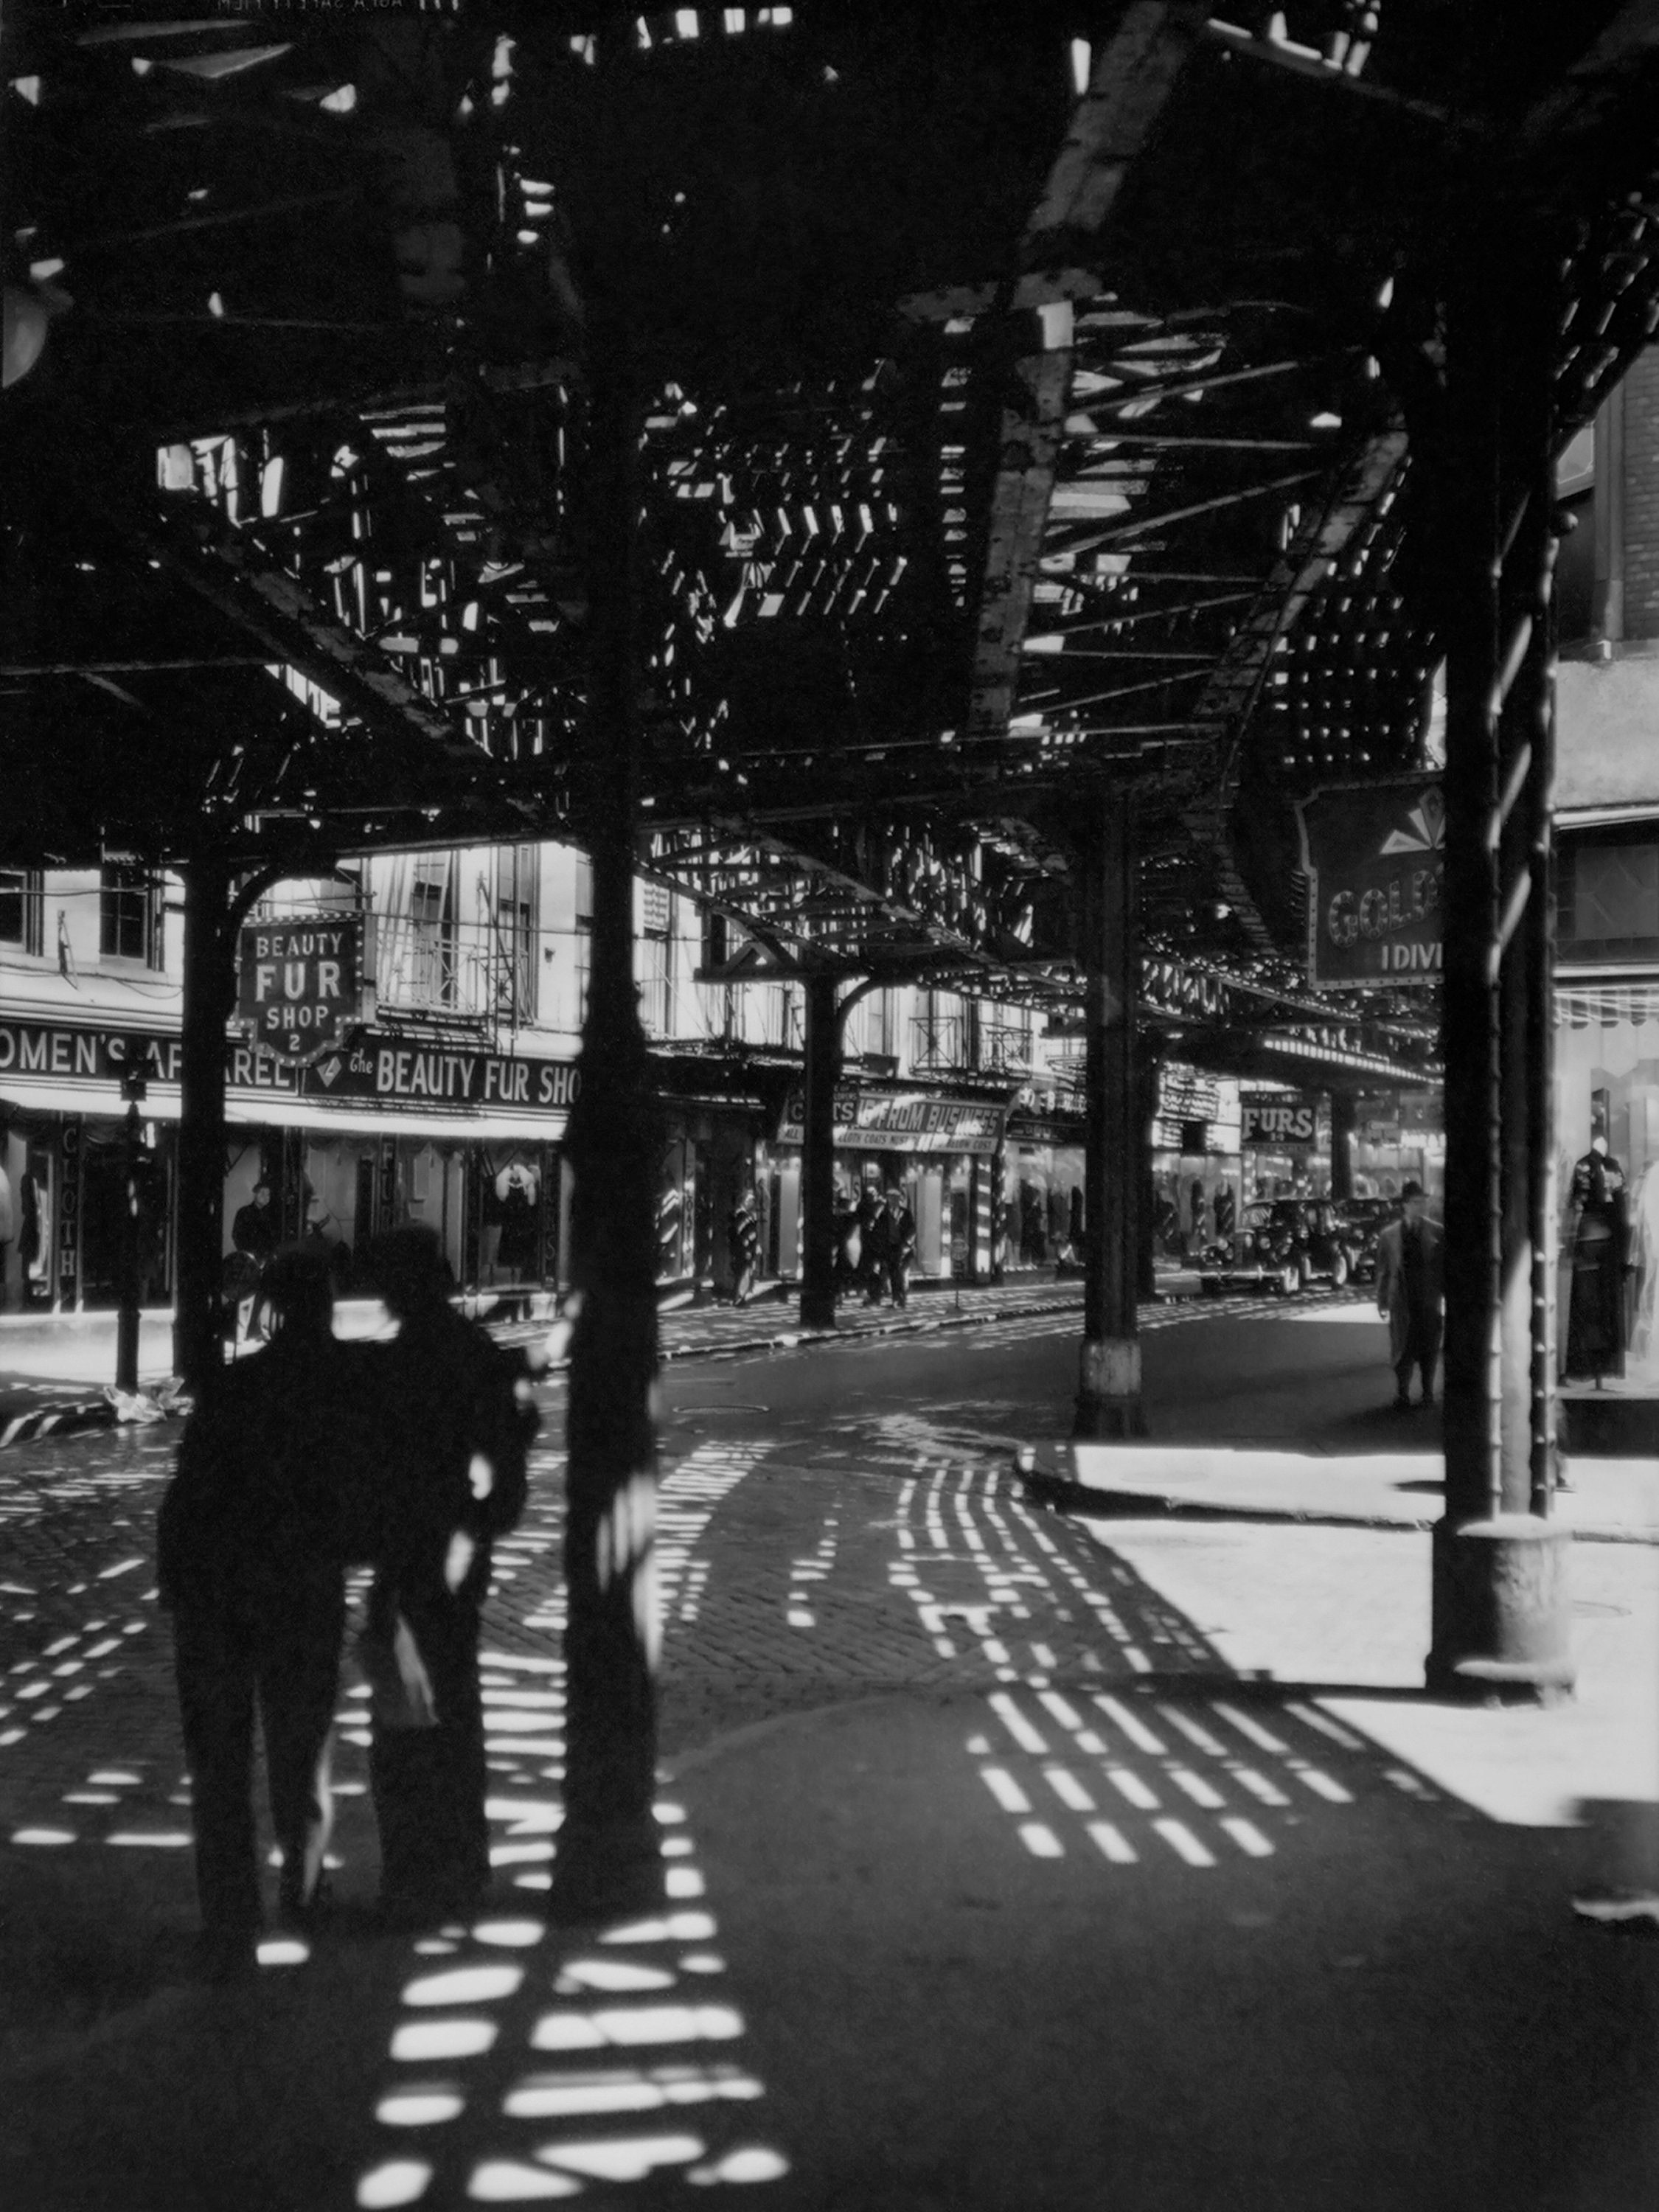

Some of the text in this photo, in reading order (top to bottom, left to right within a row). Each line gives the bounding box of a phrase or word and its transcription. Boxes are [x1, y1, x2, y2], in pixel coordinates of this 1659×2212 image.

[1328, 867, 1441, 949] GOLD
[256, 932, 344, 958] BEAUTY
[1393, 942, 1443, 970] DIVI
[255, 960, 341, 1002] FUR
[266, 1005, 329, 1030] SHOP
[0, 1028, 126, 1074] OMEN'S
[288, 1034, 300, 1051] 2
[377, 1049, 476, 1098] BEAUTY
[484, 1060, 529, 1102] FUR
[539, 1065, 582, 1105] SHO
[876, 1102, 925, 1130] FROM
[926, 1105, 999, 1135] BUSINESS
[1241, 1107, 1313, 1140] FURS
